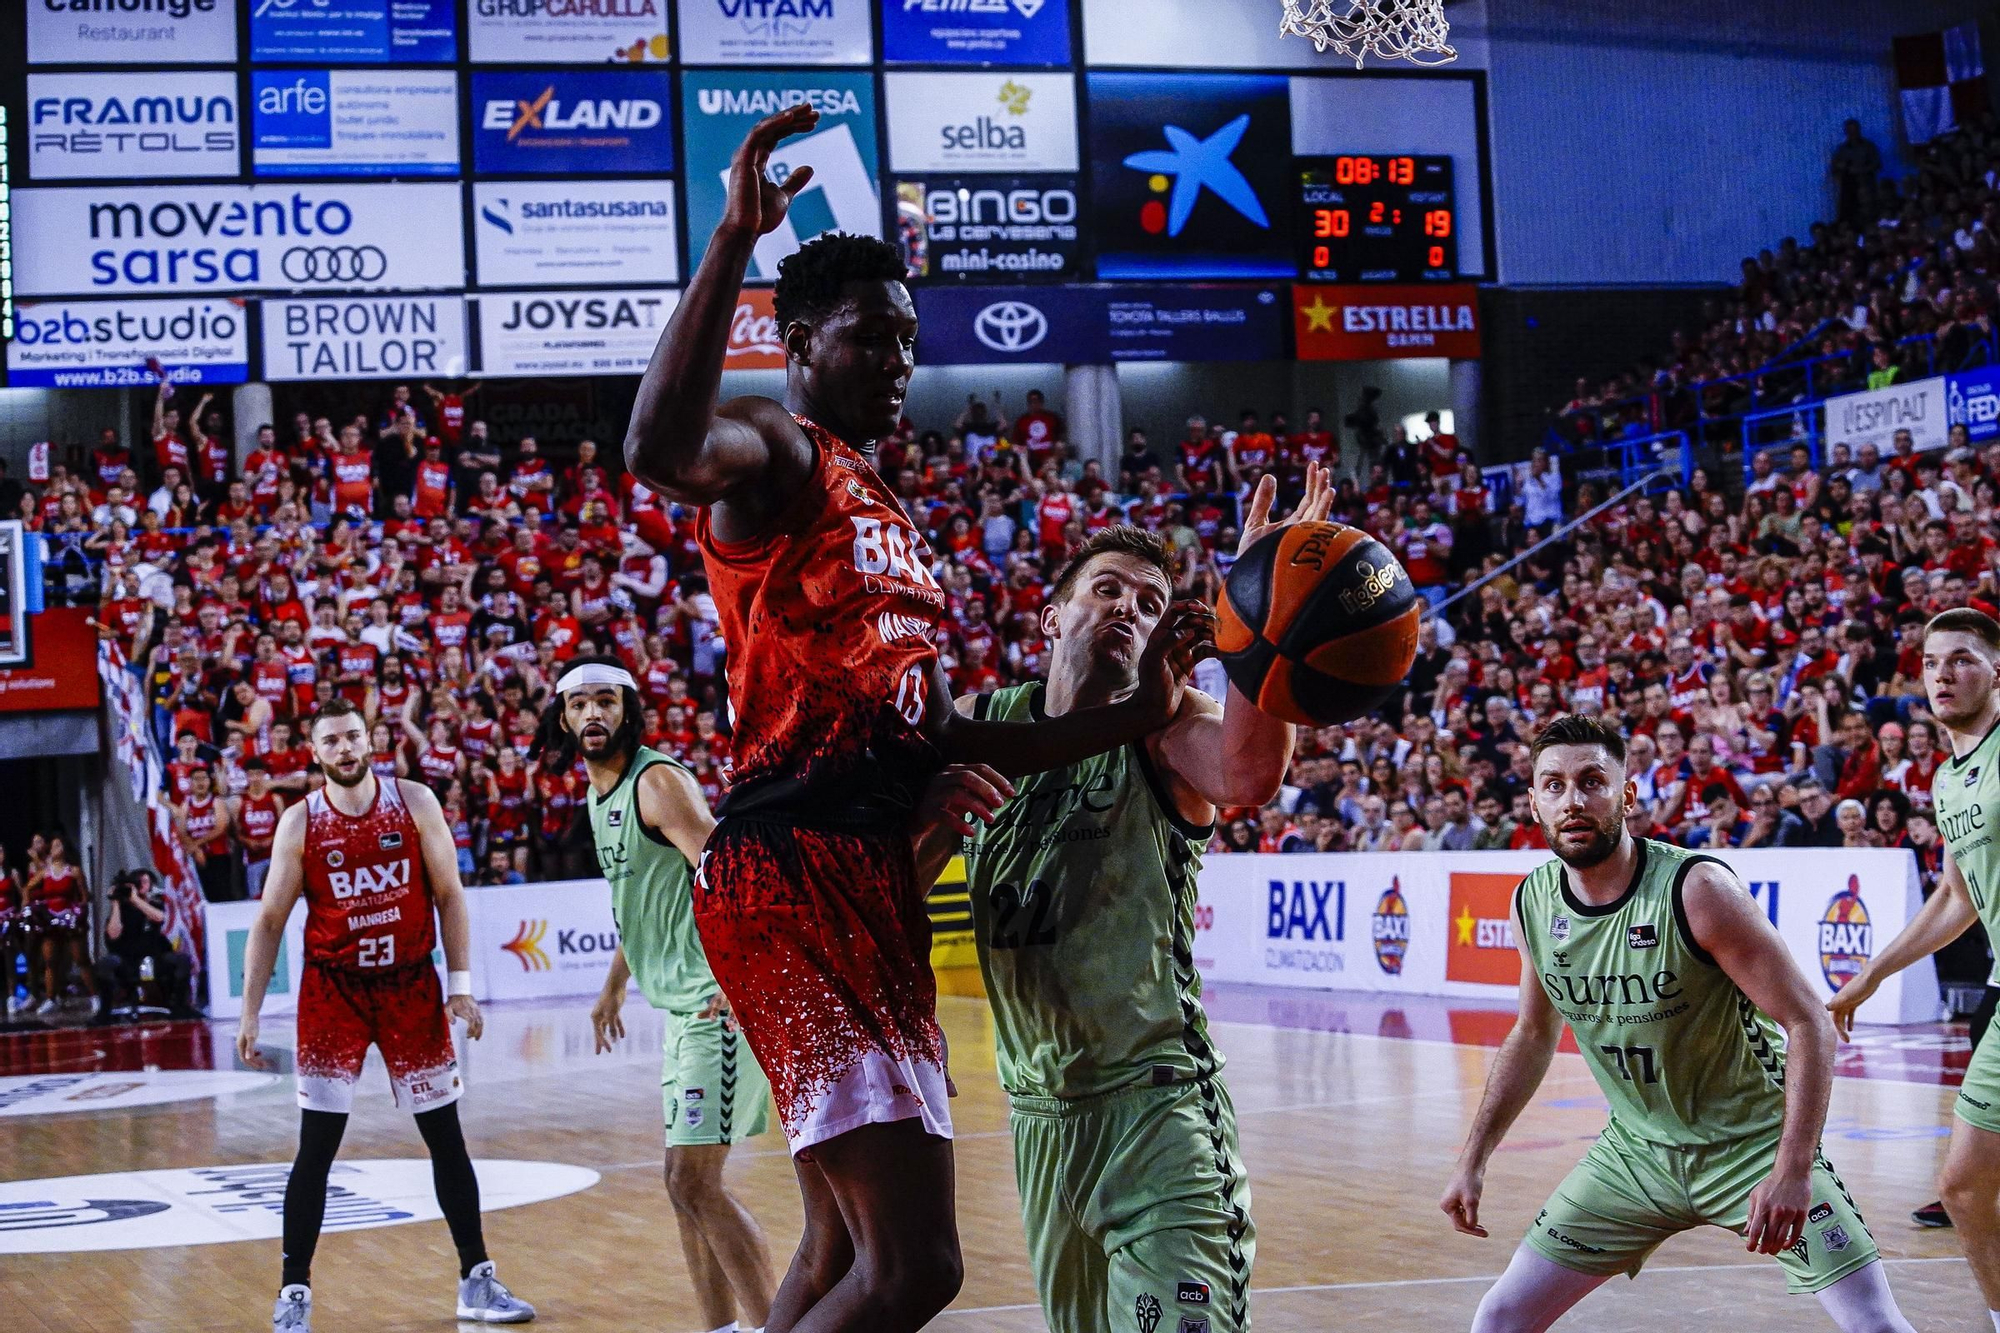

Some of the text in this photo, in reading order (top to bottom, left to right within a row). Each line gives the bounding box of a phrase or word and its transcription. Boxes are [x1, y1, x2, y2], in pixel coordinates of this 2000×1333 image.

[77, 23, 176, 41] Restaurant
[34, 95, 233, 125] FRAMUN
[258, 78, 326, 115] arfe
[483, 85, 662, 141] EXLAND
[942, 116, 1026, 150] selba
[90, 194, 352, 239] movento
[522, 199, 668, 218] santasusana
[1314, 209, 1349, 238] 30
[1424, 209, 1451, 238] 19
[91, 246, 261, 285] sarsa
[941, 248, 1065, 271] mini-casino
[1313, 245, 1444, 268] 0 0
[14, 306, 236, 346] b2b.studio
[286, 302, 437, 336] BROWN
[502, 298, 662, 330] JOYSAT
[1342, 305, 1475, 332] ESTRELLA
[287, 340, 437, 375] TAILOR
[850, 516, 941, 590] BAX
[1942, 802, 1986, 844] urne
[327, 858, 411, 900] BAXI
[347, 906, 401, 932] MANRESA
[990, 879, 1056, 949] 22
[1268, 879, 1347, 941] BAXI
[358, 934, 395, 967] 23
[557, 929, 617, 955] Kou
[1631, 936, 1657, 947] endesa
[1821, 922, 1872, 955] BAXI
[1544, 968, 1684, 1006] surne
[1606, 1015, 1614, 1024] &
[1617, 1000, 1690, 1027] pensiones
[1601, 1045, 1658, 1084] 77
[411, 1081, 434, 1095] ETL
[1810, 1208, 1829, 1222] acb
[1547, 1227, 1560, 1240] EL
[1179, 1290, 1204, 1303] acb
